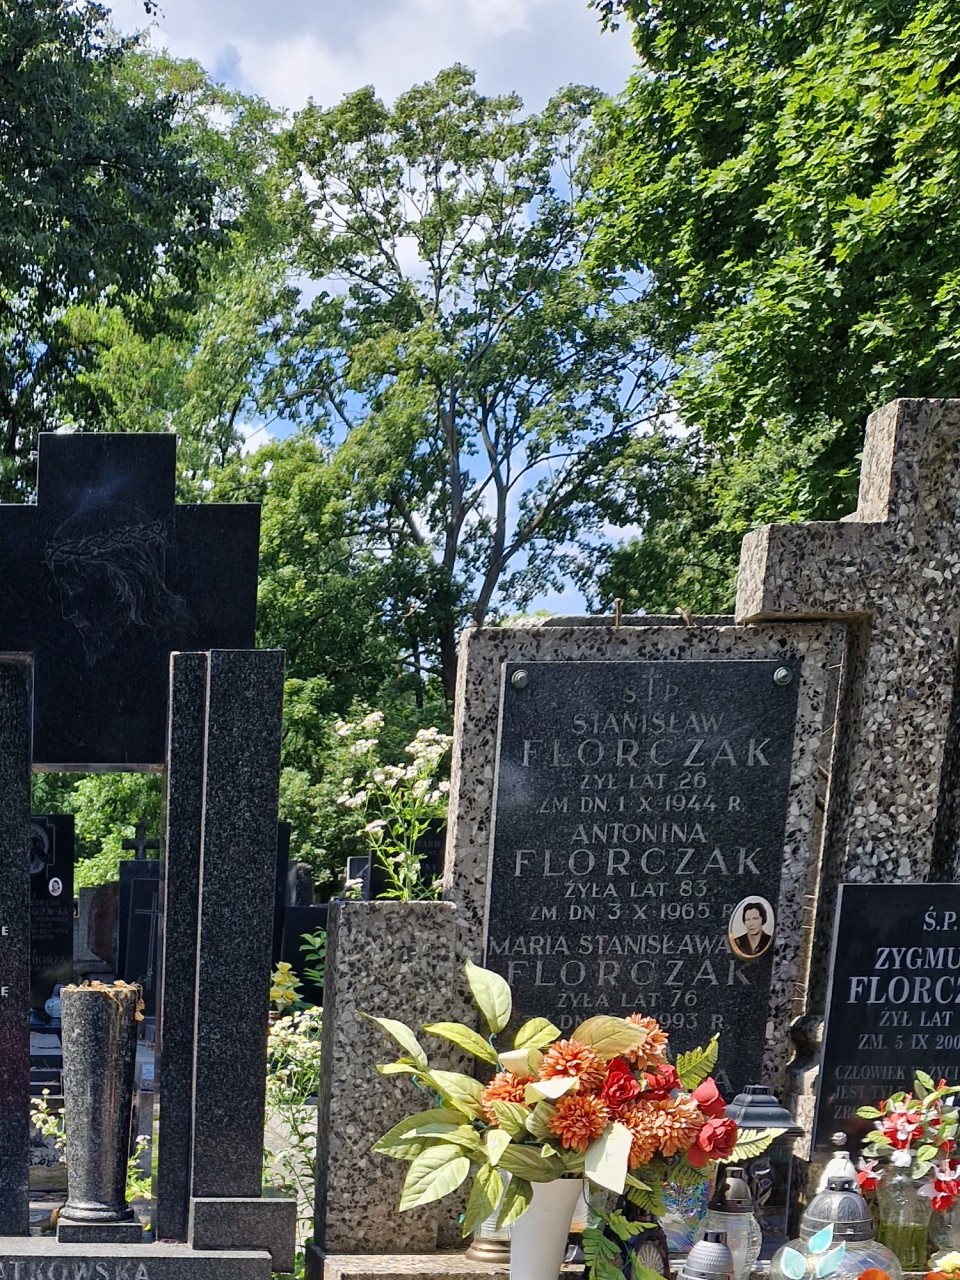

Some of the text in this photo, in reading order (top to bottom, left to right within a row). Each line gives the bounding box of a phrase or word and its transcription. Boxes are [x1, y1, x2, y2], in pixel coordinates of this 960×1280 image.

[573, 712, 724, 735] STANISŁAW
[522, 737, 772, 768] FLORCZAK
[629, 772, 708, 789] LAT 26
[665, 794, 717, 812] 1944
[570, 823, 708, 844] ANTONINA
[513, 848, 762, 877] FLORCZAK
[630, 881, 669, 897] LAT
[679, 880, 708, 897] 83
[660, 902, 710, 919] 1965
[923, 906, 958, 932] Ś.P.
[488, 933, 732, 956] MARIA STANISŁAWA
[507, 959, 752, 987] FLORCZAK
[621, 992, 658, 1007] LAT
[669, 989, 697, 1007] 76
[920, 1010, 953, 1027] LAT
[858, 1034, 888, 1050] ZM.
[911, 1034, 930, 1050] IX
